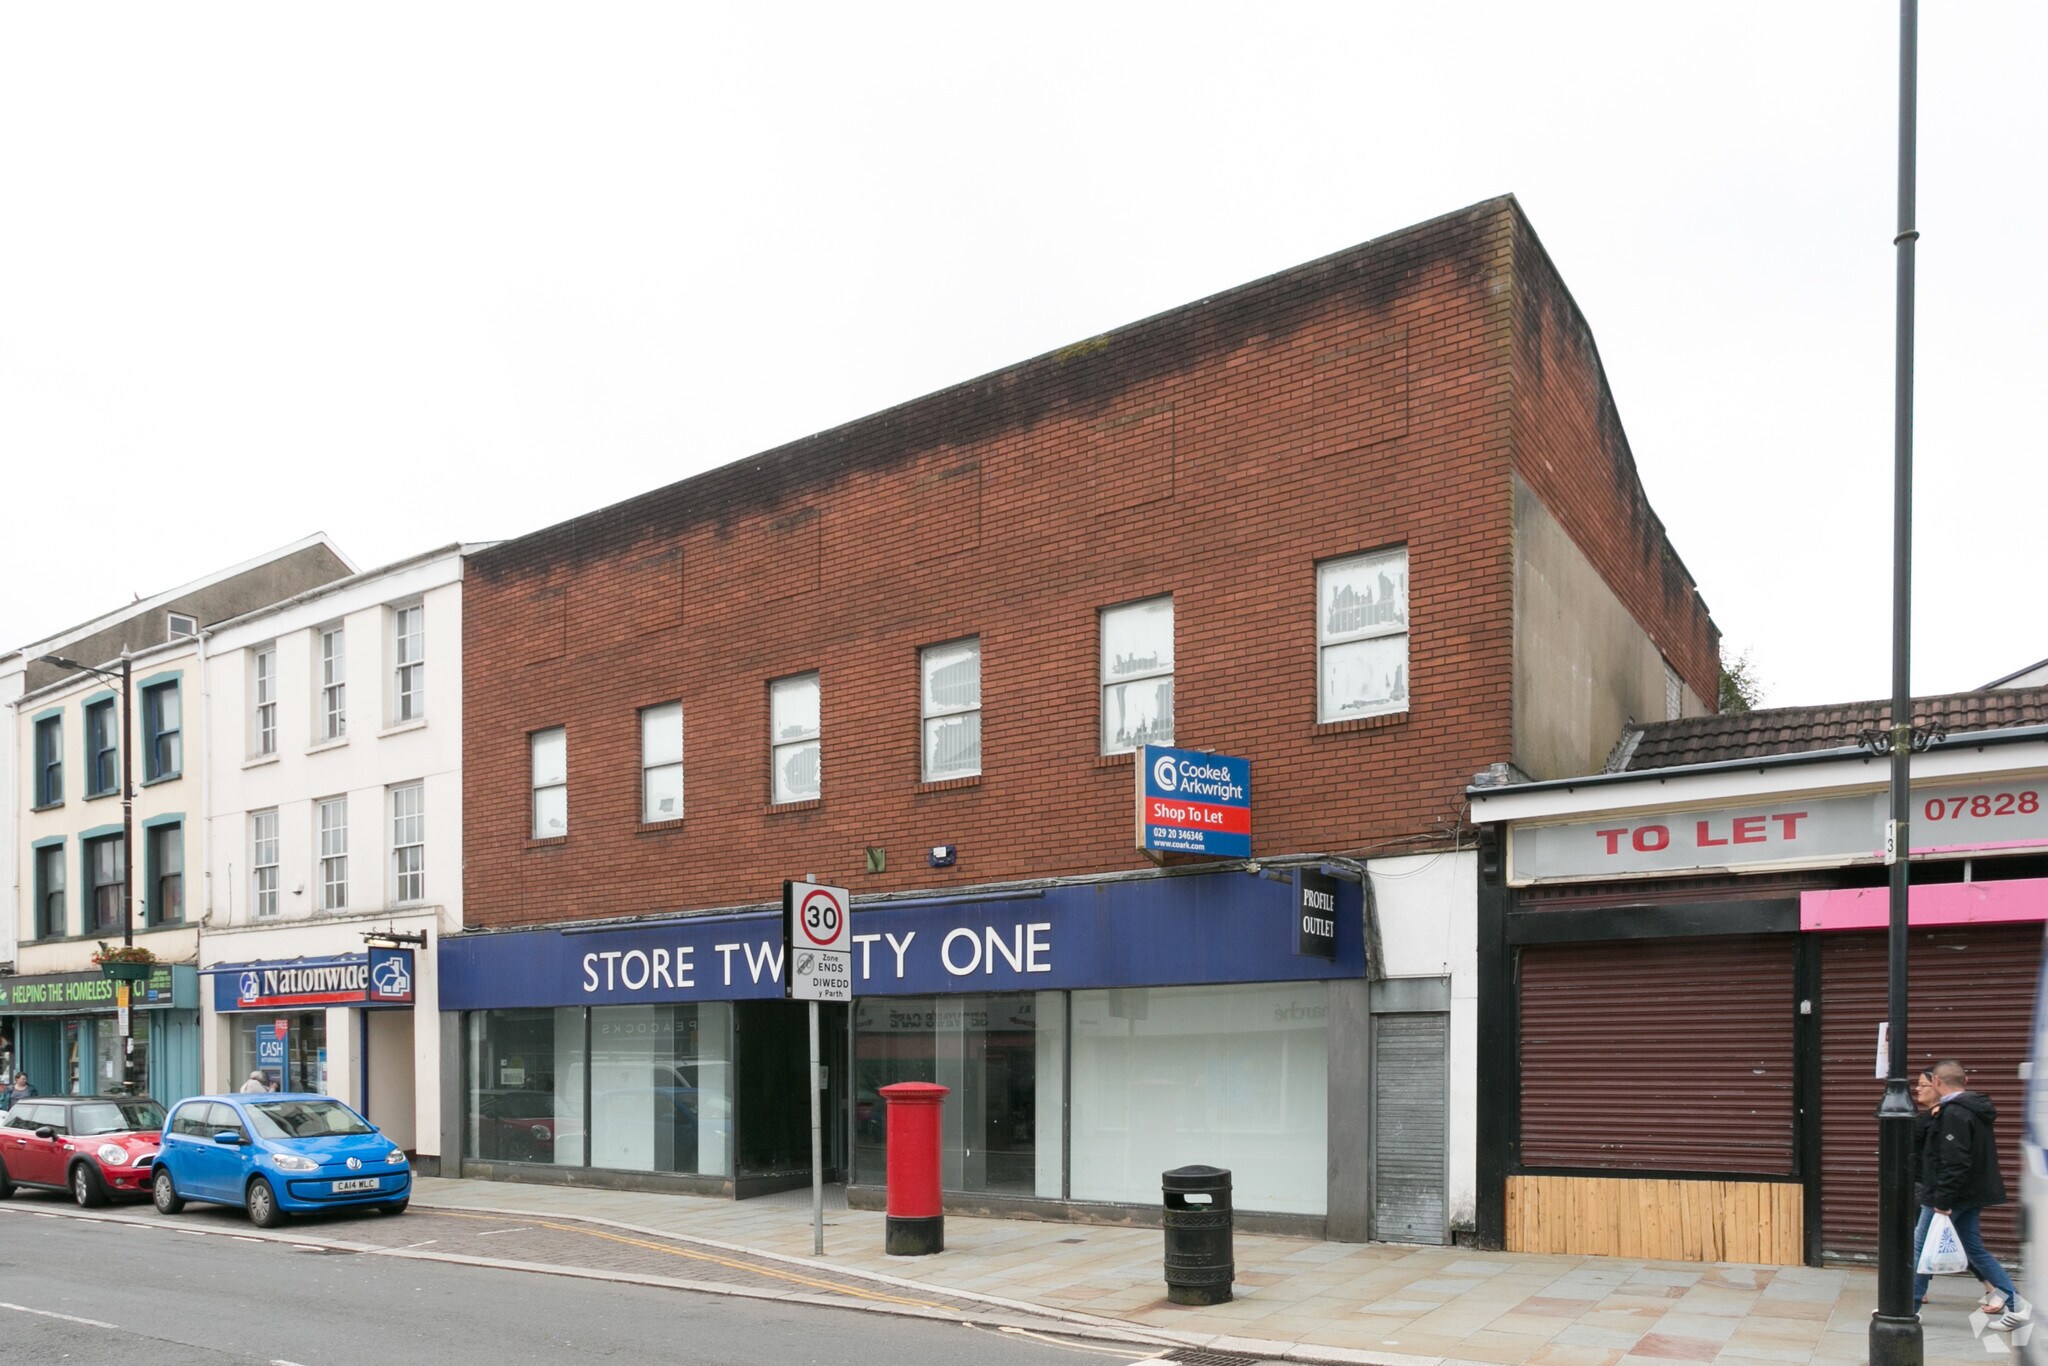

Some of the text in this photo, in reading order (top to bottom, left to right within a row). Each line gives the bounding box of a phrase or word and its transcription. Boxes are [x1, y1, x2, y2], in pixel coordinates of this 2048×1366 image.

[1180, 761, 1231, 782] Cooke&
[1180, 777, 1243, 800] Arkwright
[1154, 803, 1223, 824] Shop To Let
[1924, 791, 2039, 821] 07828
[1153, 827, 1203, 841] 029 20 346346
[1596, 812, 1808, 855] TO LET
[1154, 840, 1205, 850] www.coark.com
[1303, 888, 1334, 911] PROFILE
[807, 905, 837, 930] 30
[1303, 916, 1334, 938] OUTLET
[583, 923, 1051, 992] STORE TWTY ONE
[818, 963, 844, 973] ENDS
[822, 954, 839, 962] Zone
[264, 965, 368, 995] Nationwide
[813, 978, 849, 988] DIWEDD
[12, 984, 46, 1003] HELPING
[47, 983, 62, 1001] THE
[65, 979, 112, 1000] HOMELESS
[825, 990, 843, 998] Parth
[275, 1019, 288, 1029] FREE
[260, 1041, 283, 1057] CASH
[338, 1181, 356, 1190] CA14
